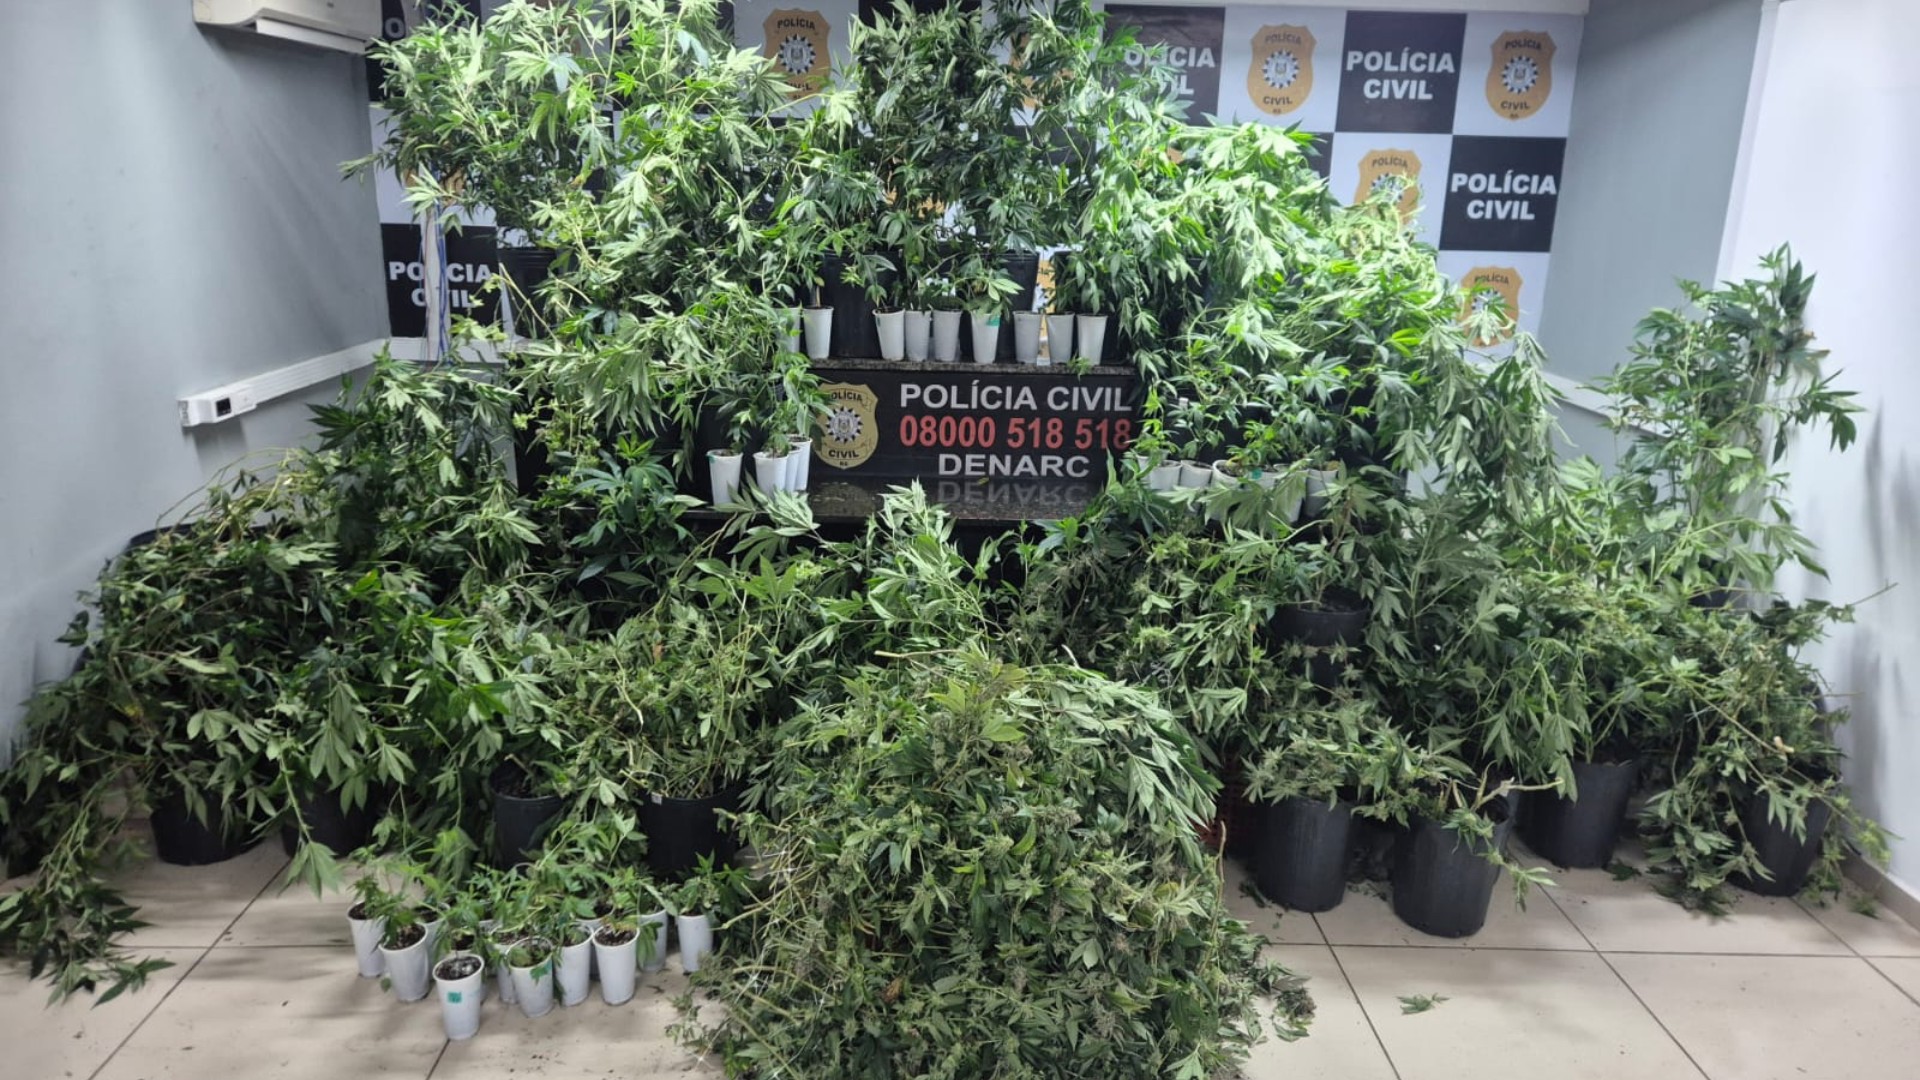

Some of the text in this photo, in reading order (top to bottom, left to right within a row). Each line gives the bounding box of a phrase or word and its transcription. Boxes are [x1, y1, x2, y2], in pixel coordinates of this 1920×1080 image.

[777, 16, 815, 30] POLÍCIA
[1265, 33, 1302, 45] POLÍCIA
[1505, 38, 1542, 50] POLÍCIA
[1346, 47, 1455, 73] POLÍCIA
[1363, 79, 1433, 100] CIVIL
[1263, 96, 1293, 105] CIVIL
[1501, 101, 1531, 110] CIVIL
[1372, 155, 1408, 168] POLÍCIA
[1451, 169, 1557, 195] POLÍCIA
[1467, 199, 1535, 220] CIVIL
[389, 261, 494, 283] POCIA
[411, 288, 479, 308] CIL
[831, 388, 863, 401] OLÍCIA
[900, 379, 1132, 412] POLÍCIA CIVIL
[900, 415, 1132, 450] 08000 518 518
[828, 449, 859, 458] CIVIL
[938, 453, 1090, 478] DENARC
